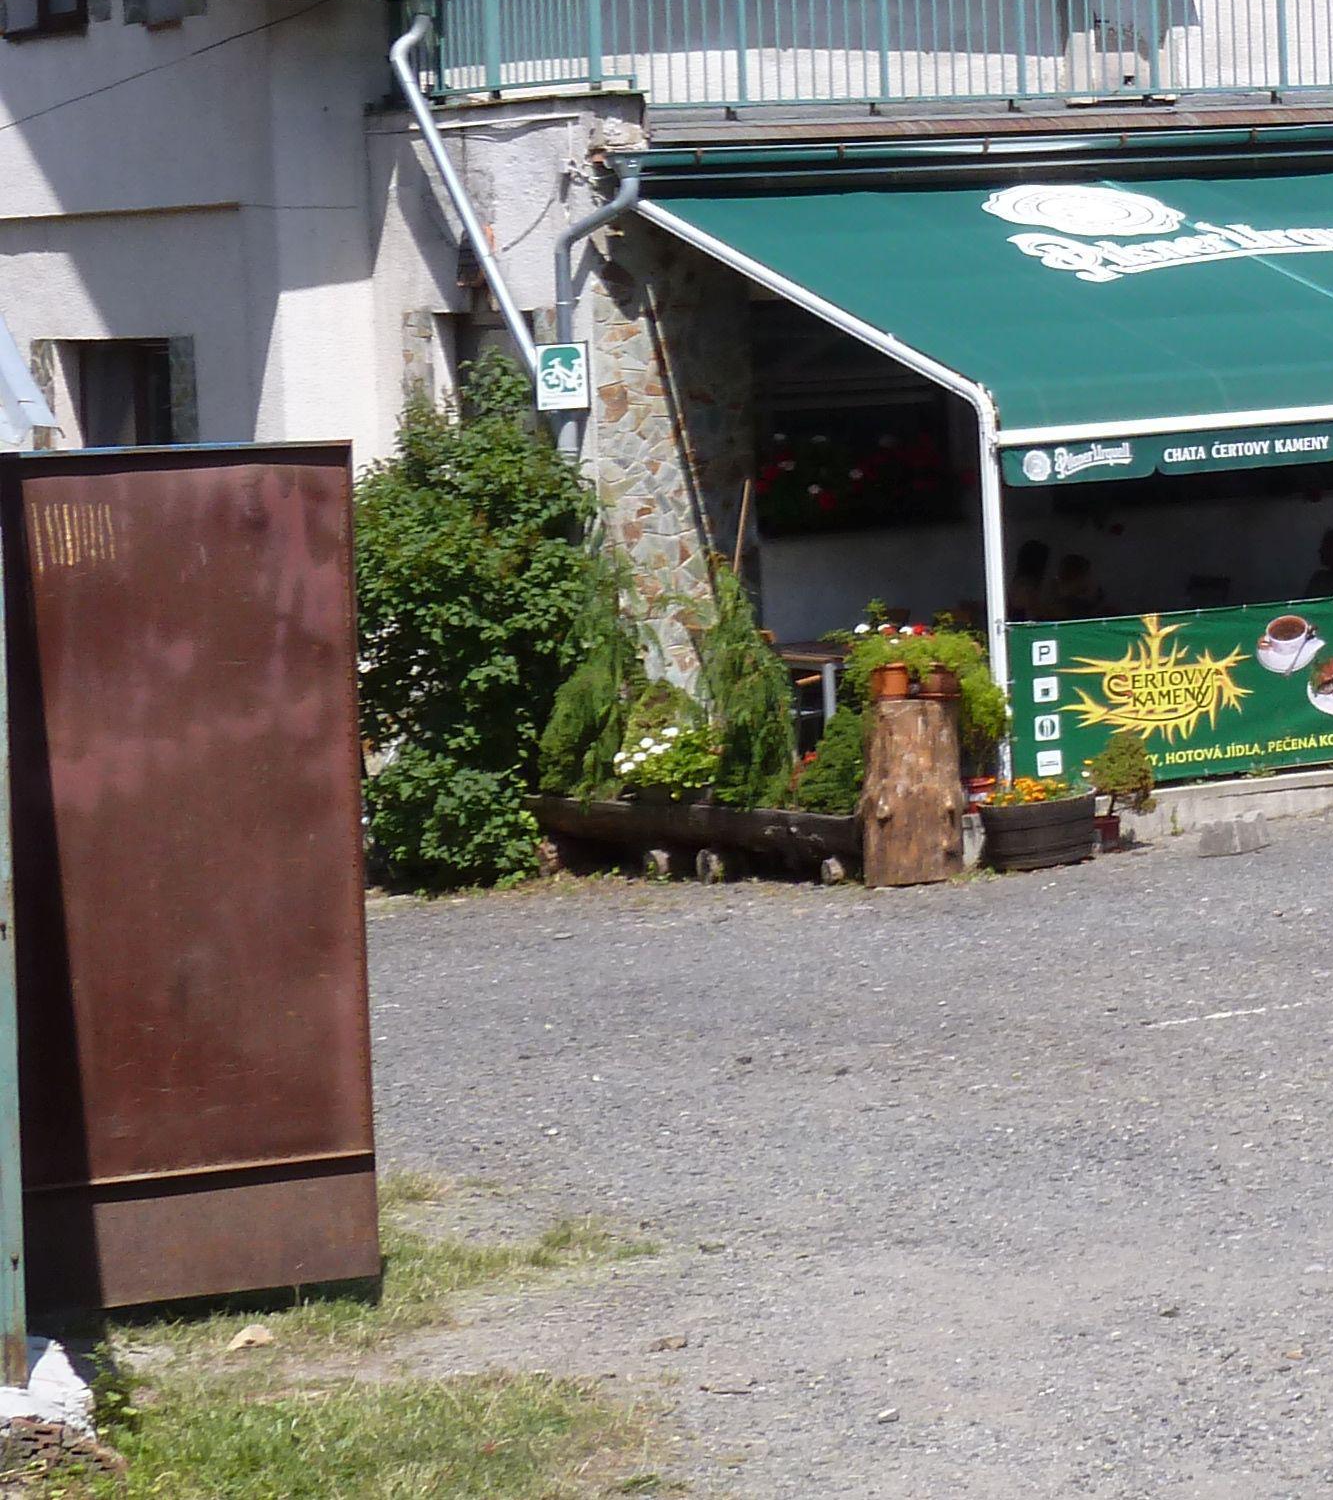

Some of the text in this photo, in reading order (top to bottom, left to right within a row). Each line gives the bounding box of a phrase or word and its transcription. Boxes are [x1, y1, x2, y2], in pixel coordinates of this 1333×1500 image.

[1163, 435, 1330, 463] CHATA ČERTOVY KAMENY
[1132, 685, 1211, 707] KAMENY
[1165, 743, 1223, 764] HOTOVÁ
[1224, 742, 1265, 759] JÍDLA,
[1268, 733, 1318, 753] PEČENÁ
